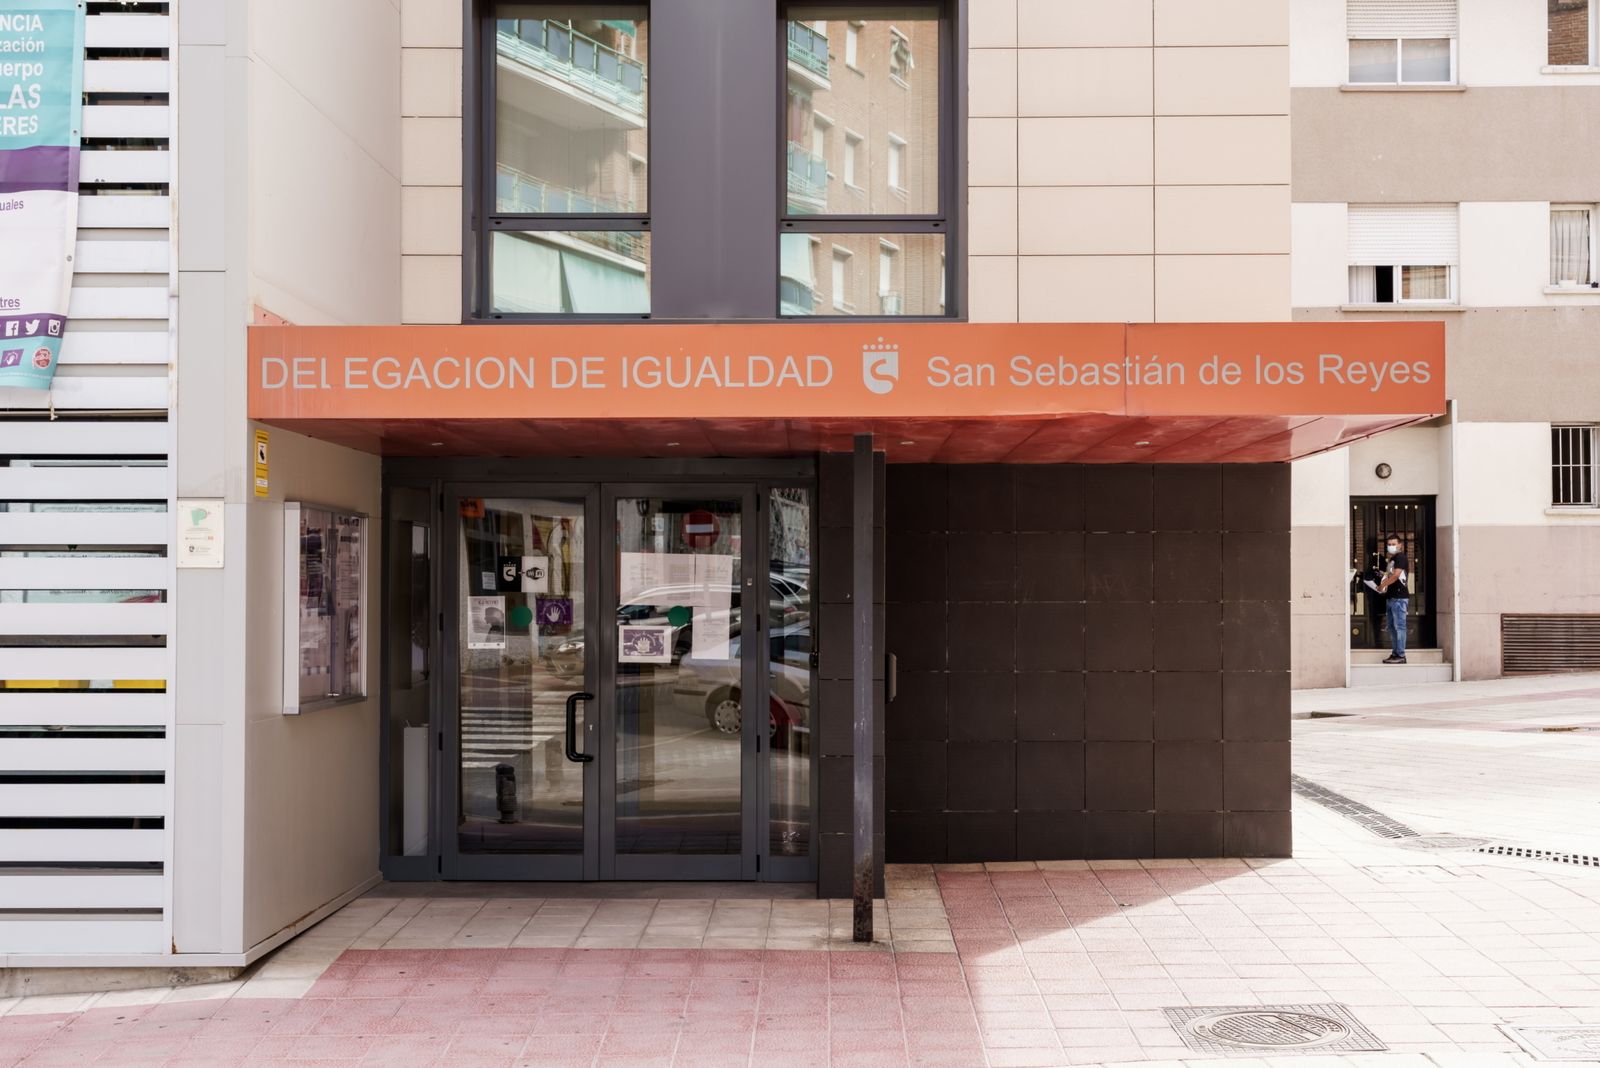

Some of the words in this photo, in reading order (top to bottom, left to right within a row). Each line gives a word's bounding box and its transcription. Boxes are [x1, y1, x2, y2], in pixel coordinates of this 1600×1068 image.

[0, 62, 44, 81] erpo
[0, 114, 39, 136] RES
[550, 356, 606, 389] DE
[621, 355, 834, 389] IGUALDAD
[926, 355, 996, 387] San
[1008, 354, 1185, 387] Sebastián
[1198, 354, 1242, 386] de
[1254, 353, 1305, 386] los
[1318, 353, 1431, 392] Reyes
